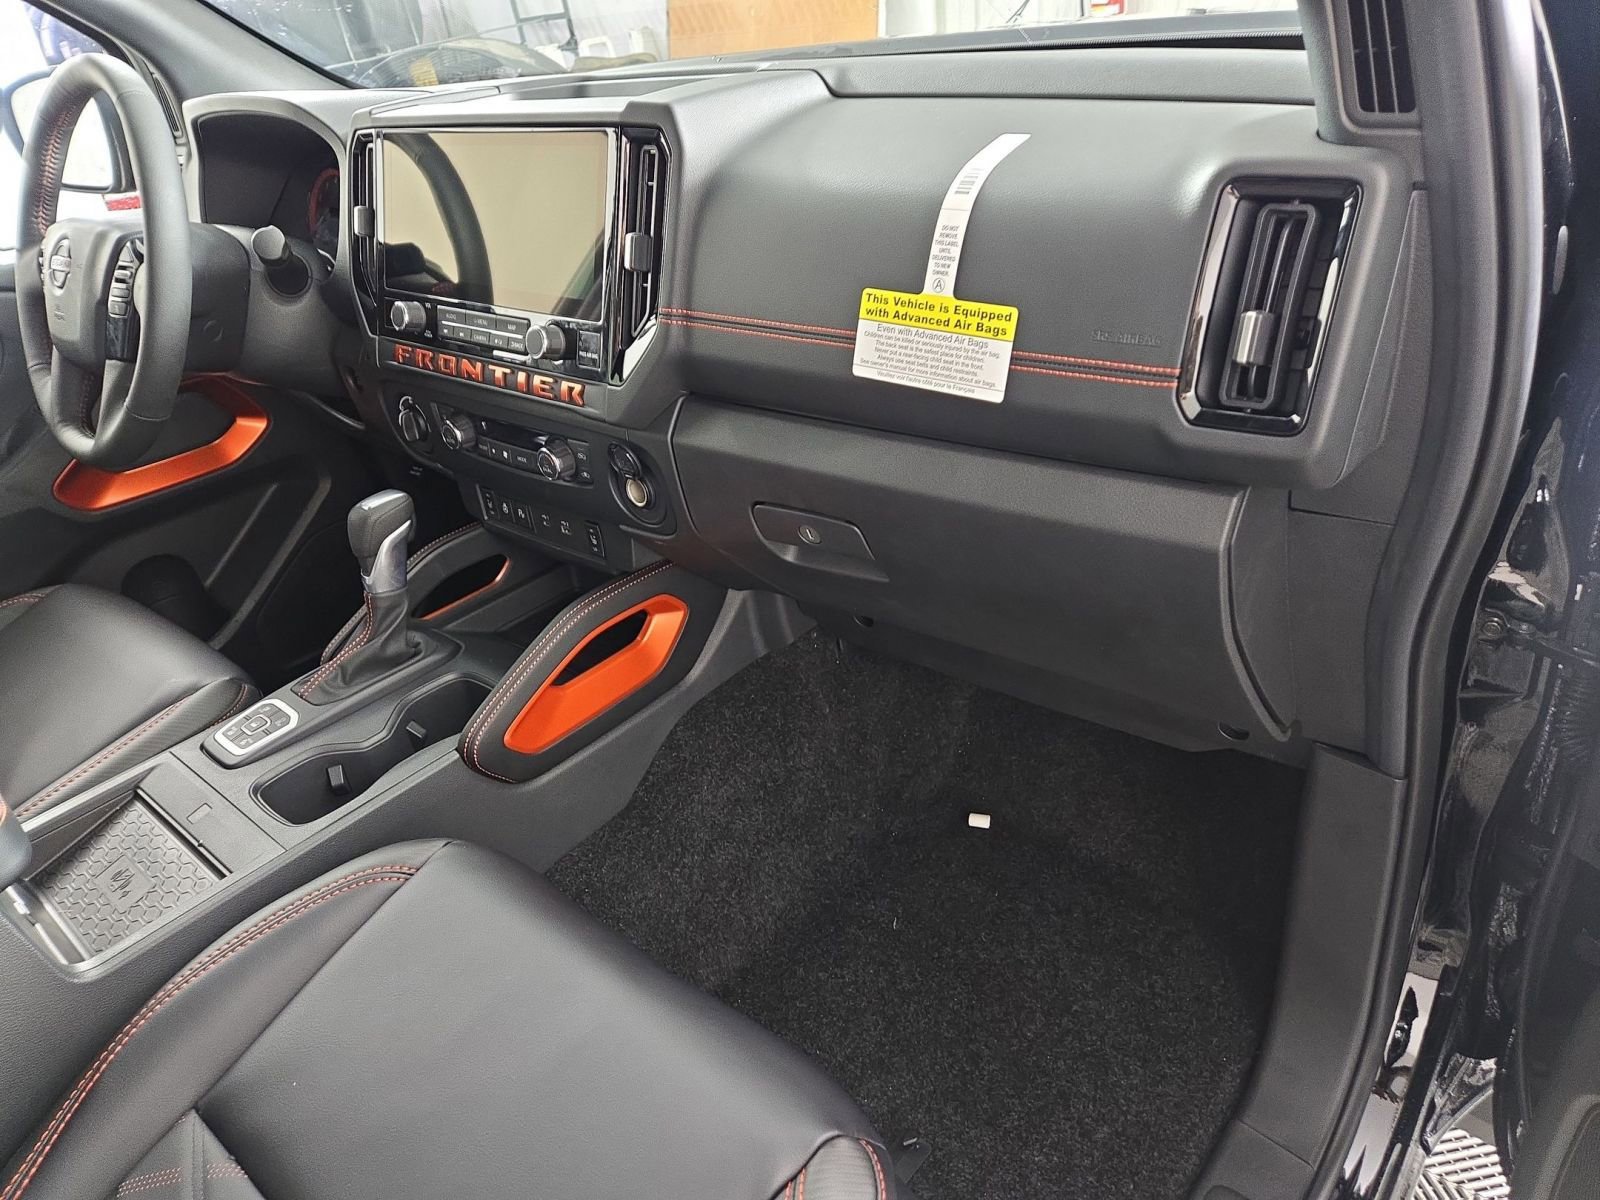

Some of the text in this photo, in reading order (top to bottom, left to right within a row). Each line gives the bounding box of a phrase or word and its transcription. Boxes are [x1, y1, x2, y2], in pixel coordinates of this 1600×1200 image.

[866, 293, 1012, 322] This Vehicle is Equipped
[866, 307, 1007, 337] with Advanced Air Bags
[864, 330, 884, 339] Children
[877, 324, 989, 350] Even with Advanced Air Bags
[394, 344, 586, 408] FRONTIER
